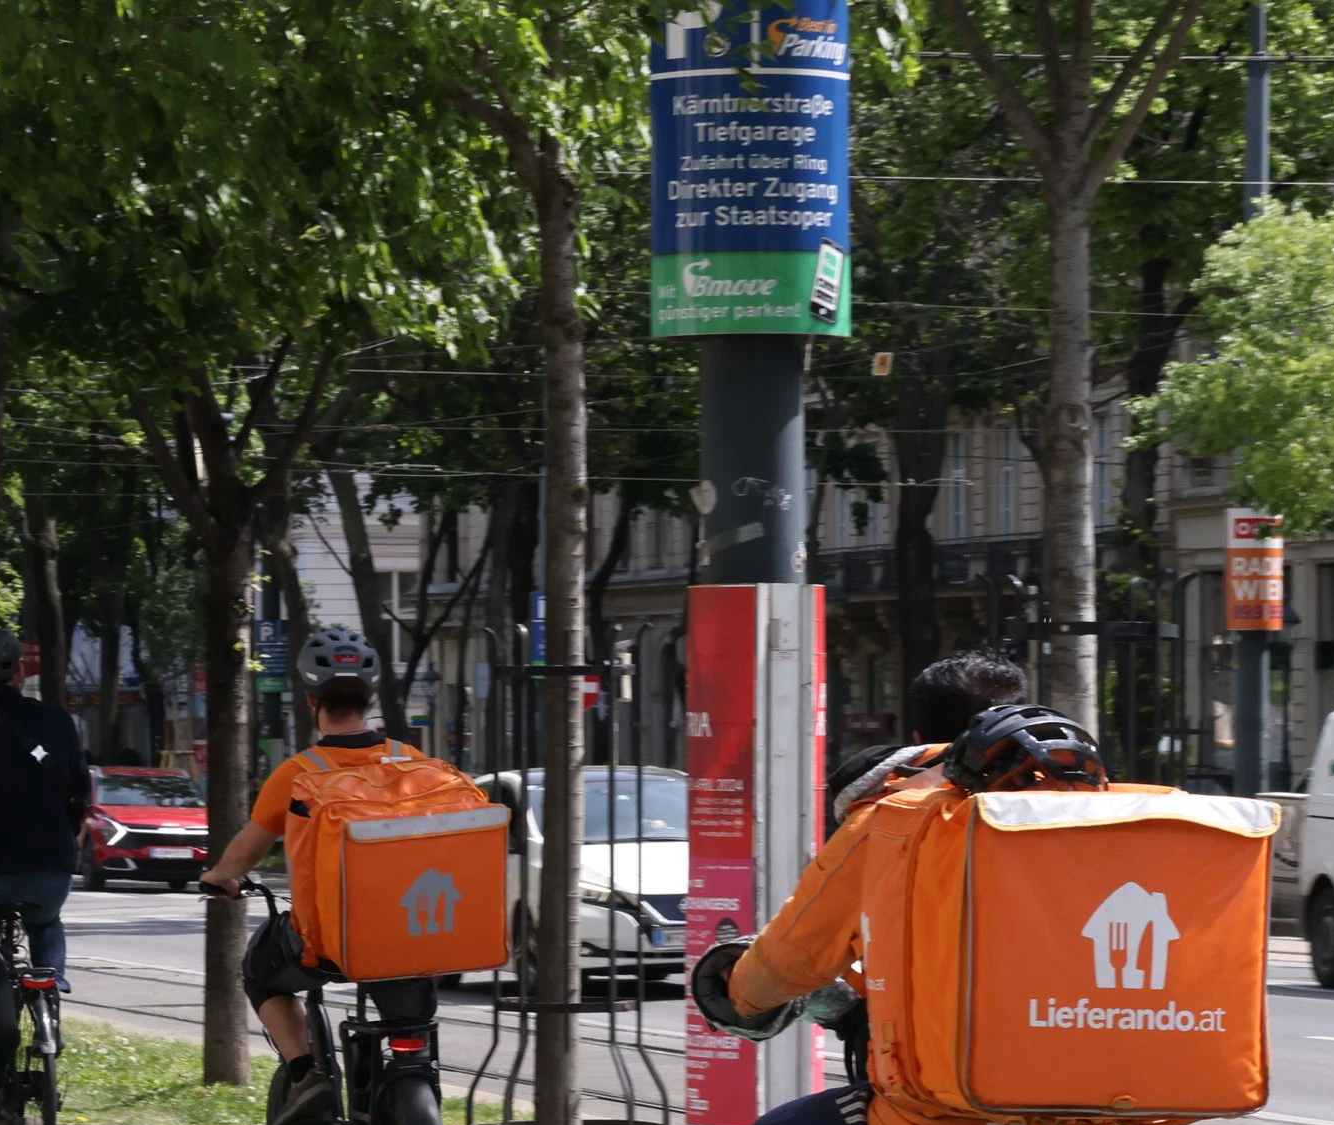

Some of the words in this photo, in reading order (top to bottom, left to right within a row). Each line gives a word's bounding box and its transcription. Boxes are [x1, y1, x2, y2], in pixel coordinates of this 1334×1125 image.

[777, 33, 847, 66] Parking
[672, 93, 834, 118] Kärntnerstraße
[693, 121, 816, 147] Tiefgarage
[679, 153, 745, 172] Zufahrt
[748, 153, 791, 170] über
[793, 154, 828, 175] Ring
[667, 178, 758, 201] Direkter
[763, 177, 839, 205] Zugang
[675, 211, 710, 228] zur
[714, 205, 834, 231] Staatsoper
[658, 304, 728, 325] günstiger
[733, 303, 802, 321] parken!
[1028, 997, 1227, 1033] Lieferando.at
